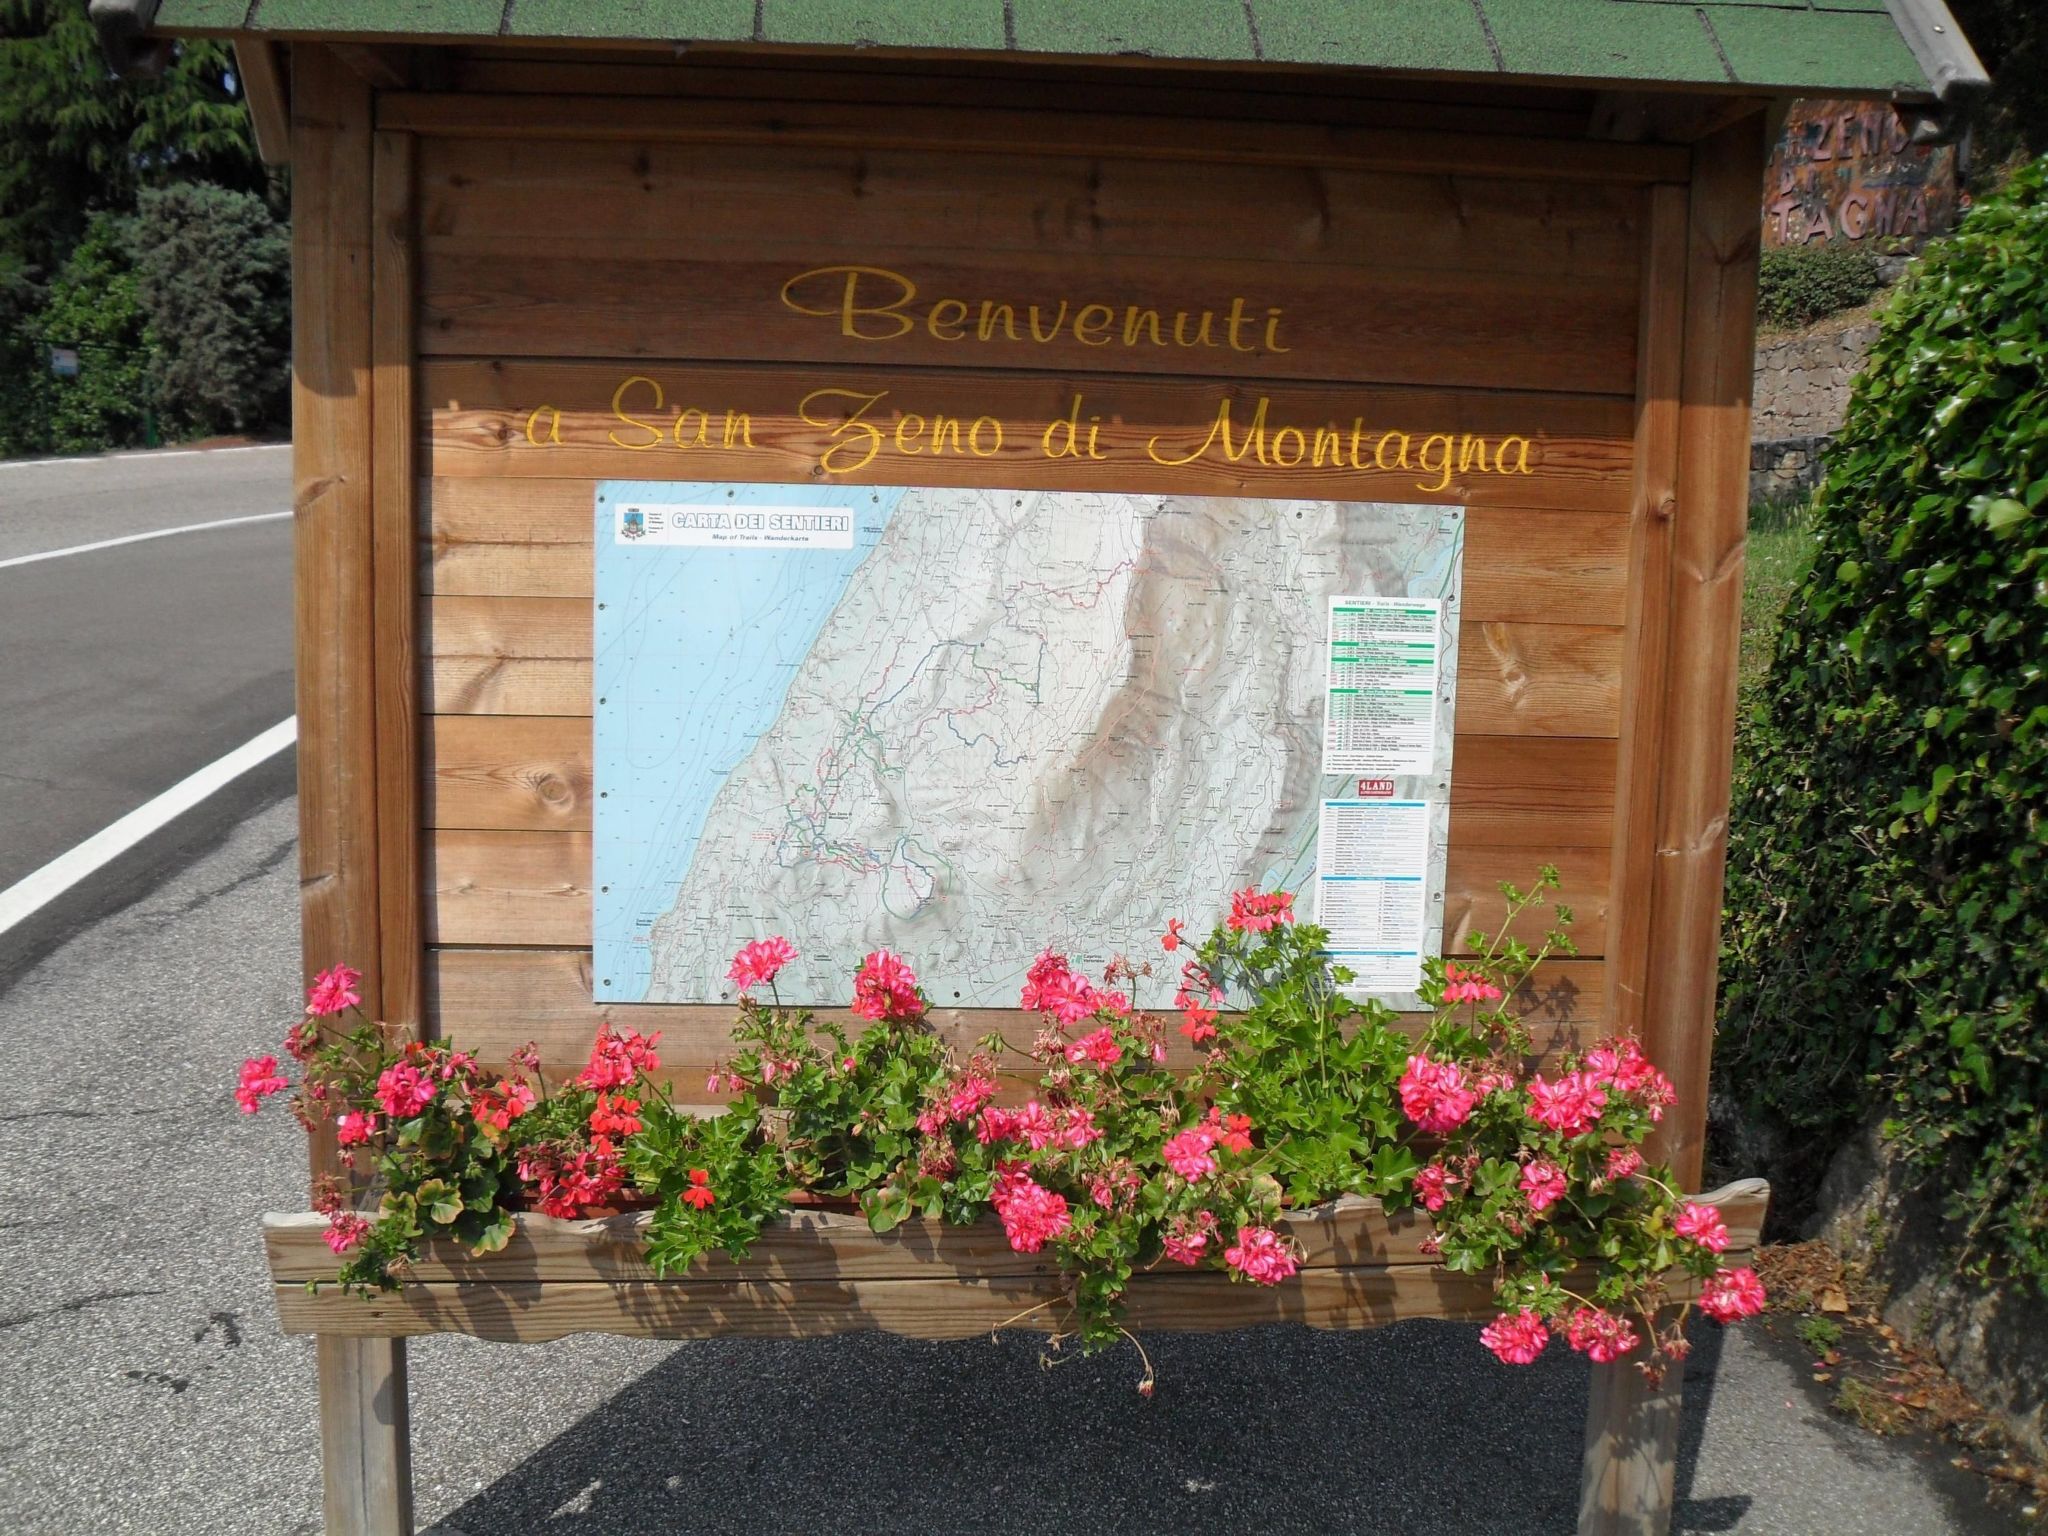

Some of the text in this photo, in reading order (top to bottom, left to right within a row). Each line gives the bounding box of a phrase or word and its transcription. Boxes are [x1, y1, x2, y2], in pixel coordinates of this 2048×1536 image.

[781, 265, 1291, 353] Benvenuti
[525, 375, 1534, 493] a San Zeno di Montagna
[672, 512, 731, 530] CARTA
[734, 513, 766, 531] DEI
[768, 514, 850, 533] SENTIERI
[711, 533, 728, 542] Map
[729, 533, 738, 541] of
[1359, 780, 1394, 791] 4LAND
